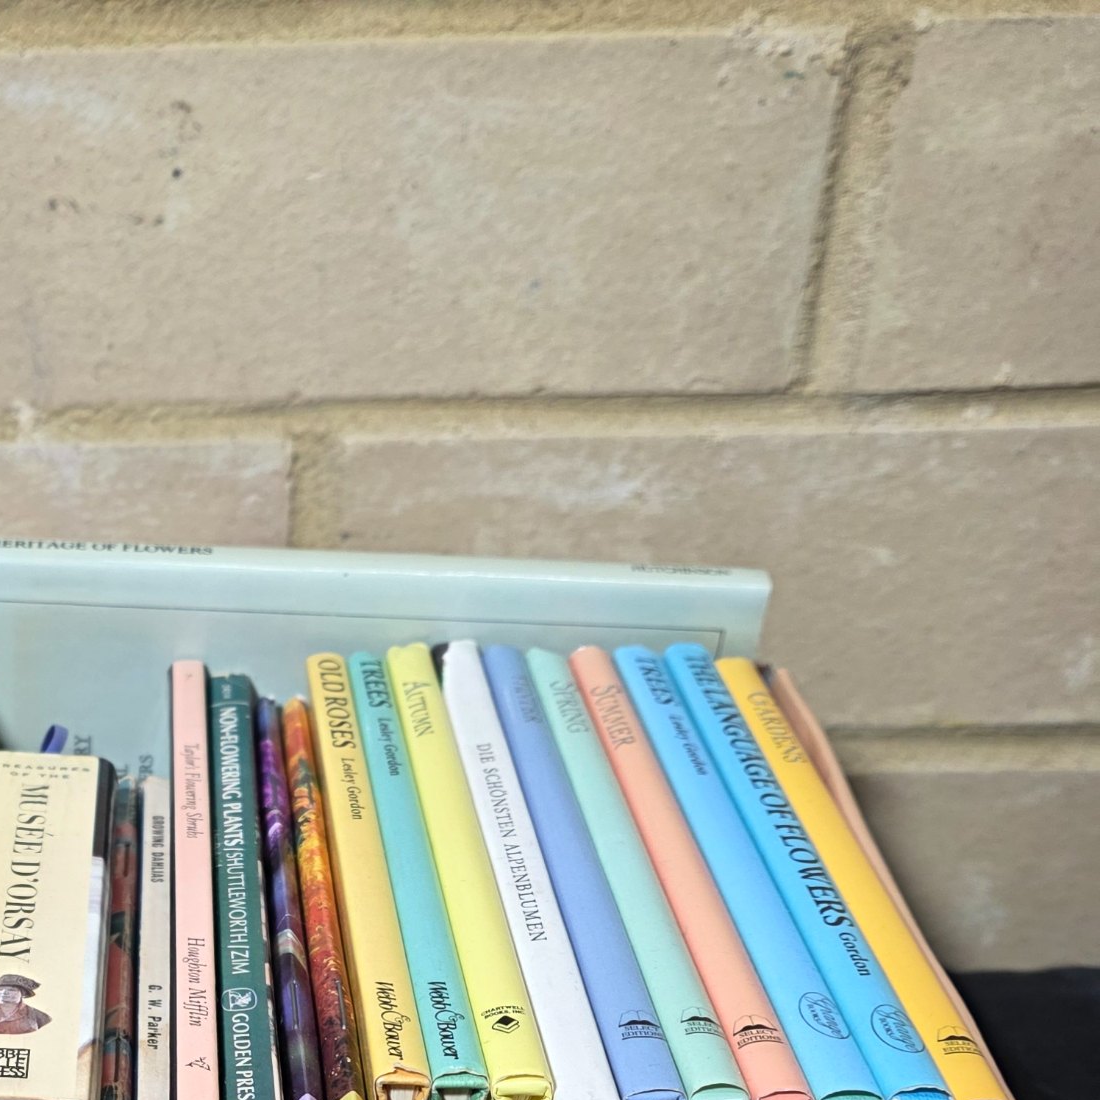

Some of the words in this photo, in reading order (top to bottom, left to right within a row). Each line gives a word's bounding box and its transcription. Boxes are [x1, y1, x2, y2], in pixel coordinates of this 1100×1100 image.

[91, 542, 117, 552] OF
[122, 543, 214, 556] FLOWERS
[317, 659, 345, 693] OLD
[360, 659, 392, 709] TREES
[635, 655, 678, 706] TREES
[325, 696, 356, 749] ROSES
[403, 681, 435, 738] AUTUMN
[589, 684, 637, 750] SUMMER
[748, 690, 806, 764] GARDENS
[377, 717, 393, 742] Lesley
[702, 687, 781, 790] LANGUAGE
[219, 706, 243, 799] NON-FLOWERING
[341, 757, 357, 785] Lesley
[383, 743, 402, 777] Gordon
[476, 743, 495, 765] DIE
[180, 772, 202, 812] Flowering
[346, 785, 363, 820] Gordon
[483, 766, 517, 839] SCHÖNSTEN
[759, 790, 796, 820] OF
[13, 783, 53, 857] MUSÉE
[151, 815, 166, 848] GROWING
[185, 811, 205, 839] Shrubs
[223, 803, 245, 847] PLANTS
[150, 850, 165, 883] DAHLIAS
[774, 820, 855, 927] FLOWERS
[226, 852, 249, 943] SHUTTLEWORTH
[504, 843, 547, 943] ALPENBLUMEN
[182, 937, 205, 984] Houghton
[230, 949, 252, 975] ZIM
[838, 930, 872, 977] Gordon
[147, 984, 163, 993] G.
[147, 999, 163, 1010] W.
[183, 987, 209, 1027] Mifflin
[481, 1005, 525, 1016] CHARTWELL
[146, 1015, 162, 1050] Parker
[231, 1012, 255, 1067] GOLDEN
[622, 1031, 665, 1039] EDITIONS
[737, 1035, 782, 1047] EDITIONS
[739, 1030, 774, 1038] SELECT
